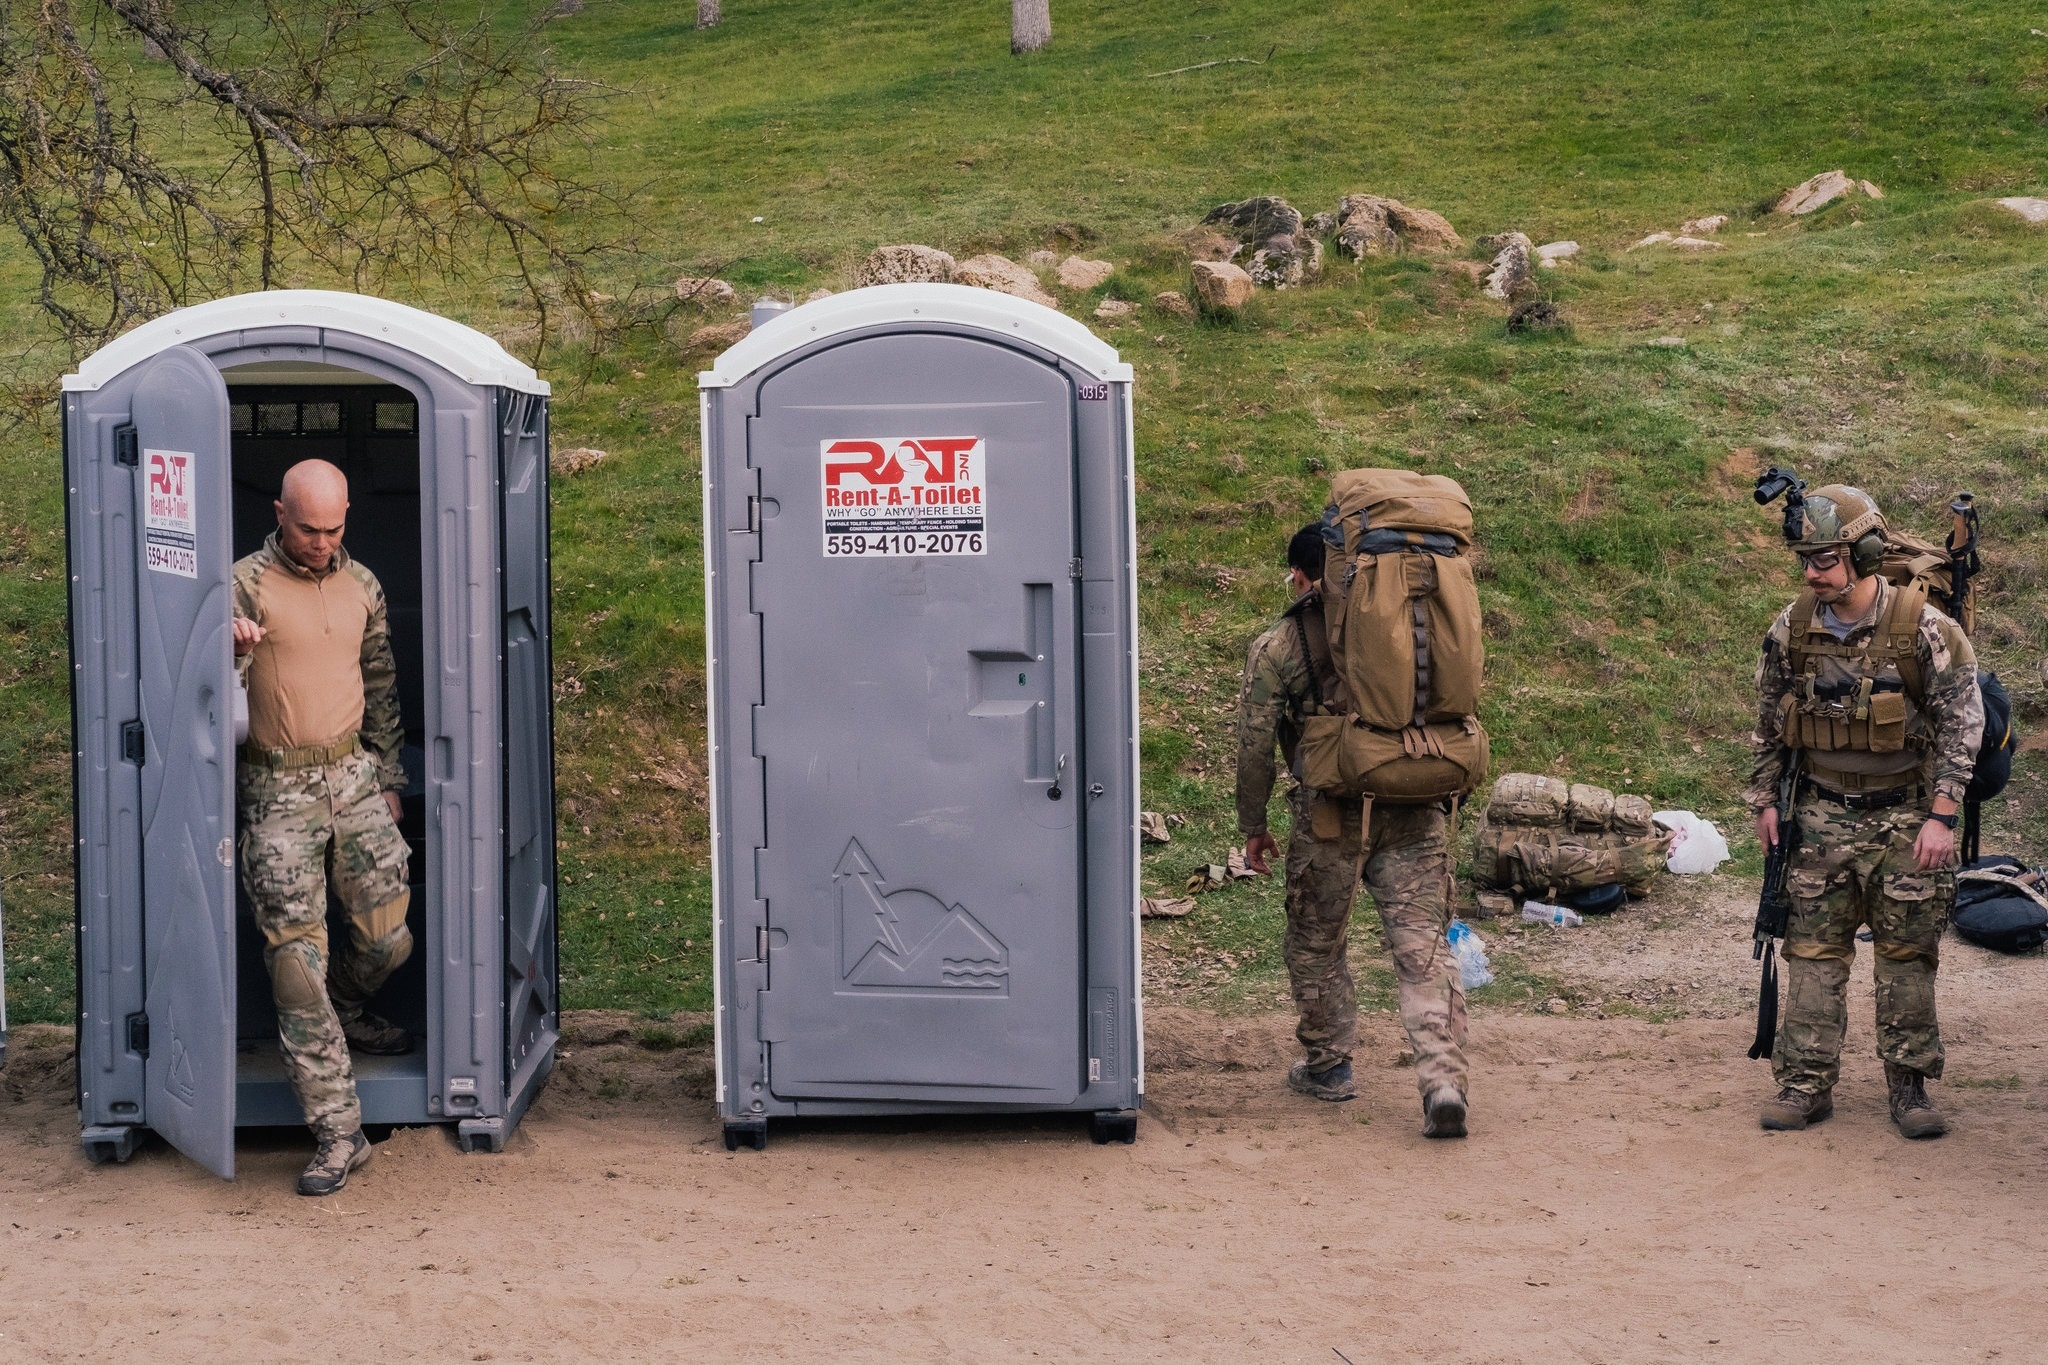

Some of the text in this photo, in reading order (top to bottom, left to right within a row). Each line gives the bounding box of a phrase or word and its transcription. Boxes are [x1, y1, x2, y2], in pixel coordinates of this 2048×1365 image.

[1082, 385, 1105, 399] 0315
[826, 439, 978, 485] RAT
[959, 453, 970, 481] INC
[150, 454, 187, 496] RAT
[826, 485, 982, 508] Rent-A-Toilet
[827, 508, 852, 518] WHY
[884, 506, 949, 517] ANYWHERE
[952, 505, 982, 515] ELSE
[827, 533, 983, 555] 559-410-2076
[148, 546, 194, 573] 559-410-2076
